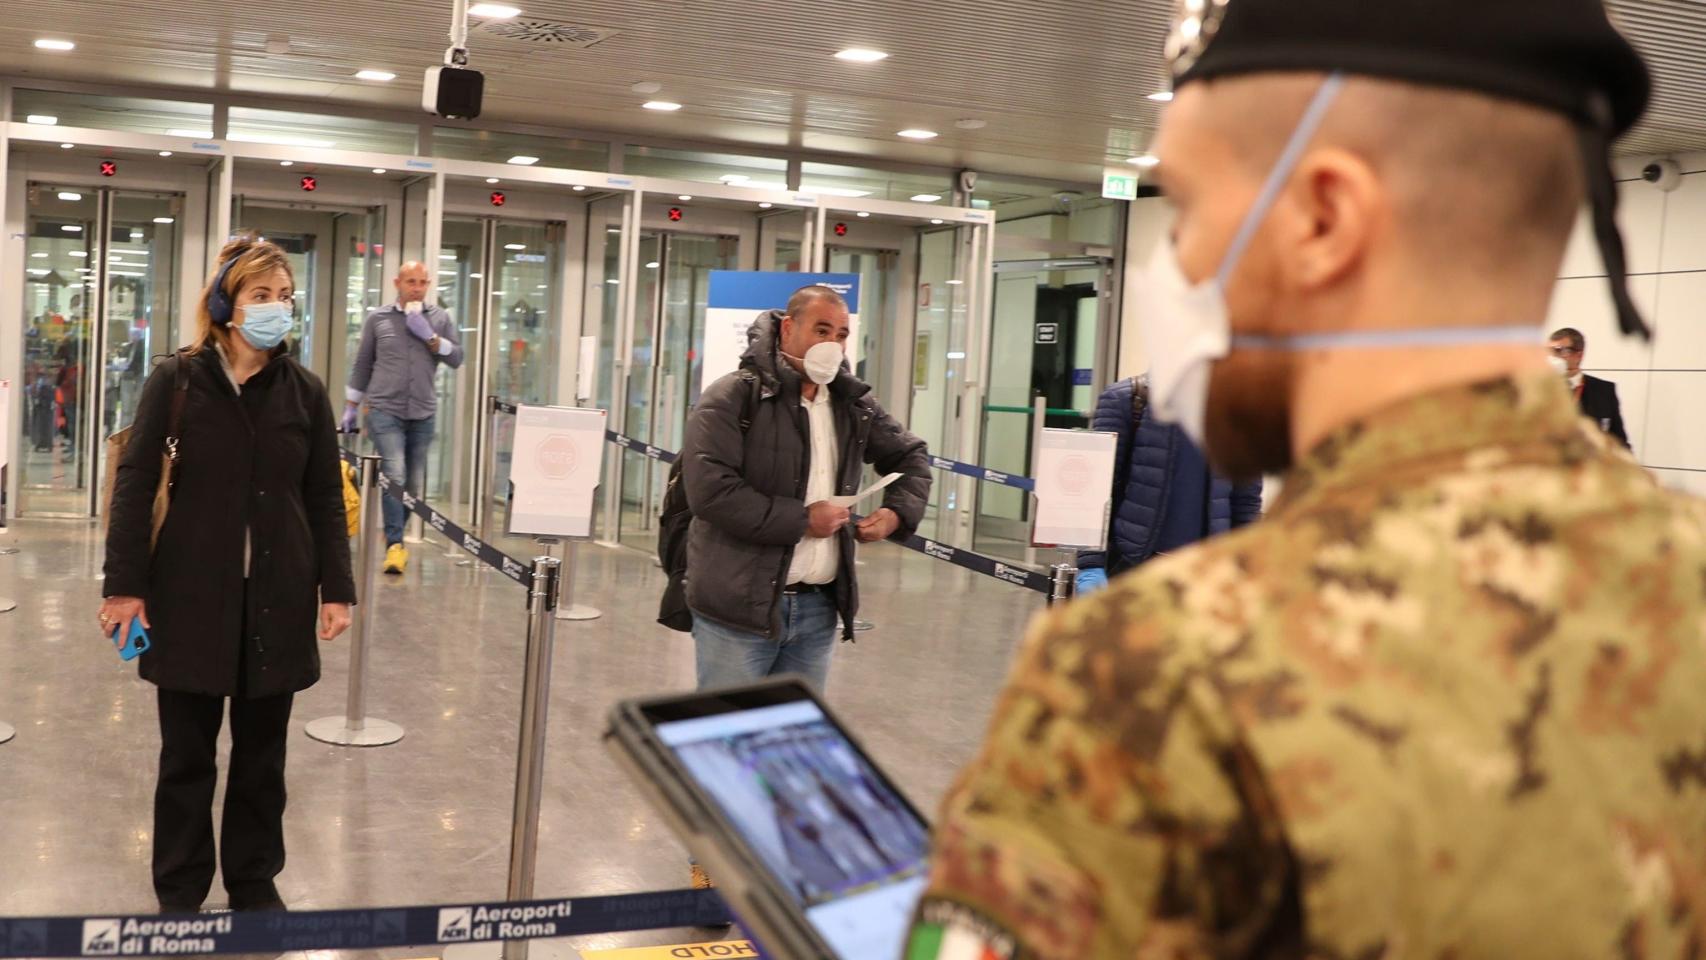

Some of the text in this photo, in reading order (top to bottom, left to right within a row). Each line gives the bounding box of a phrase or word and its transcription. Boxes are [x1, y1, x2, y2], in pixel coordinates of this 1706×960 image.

[473, 900, 572, 923] Aeroporti
[122, 916, 233, 938] Aeroporti
[473, 922, 557, 940] di Roma
[121, 936, 216, 954] di Roma
[671, 943, 757, 958] HOLD
